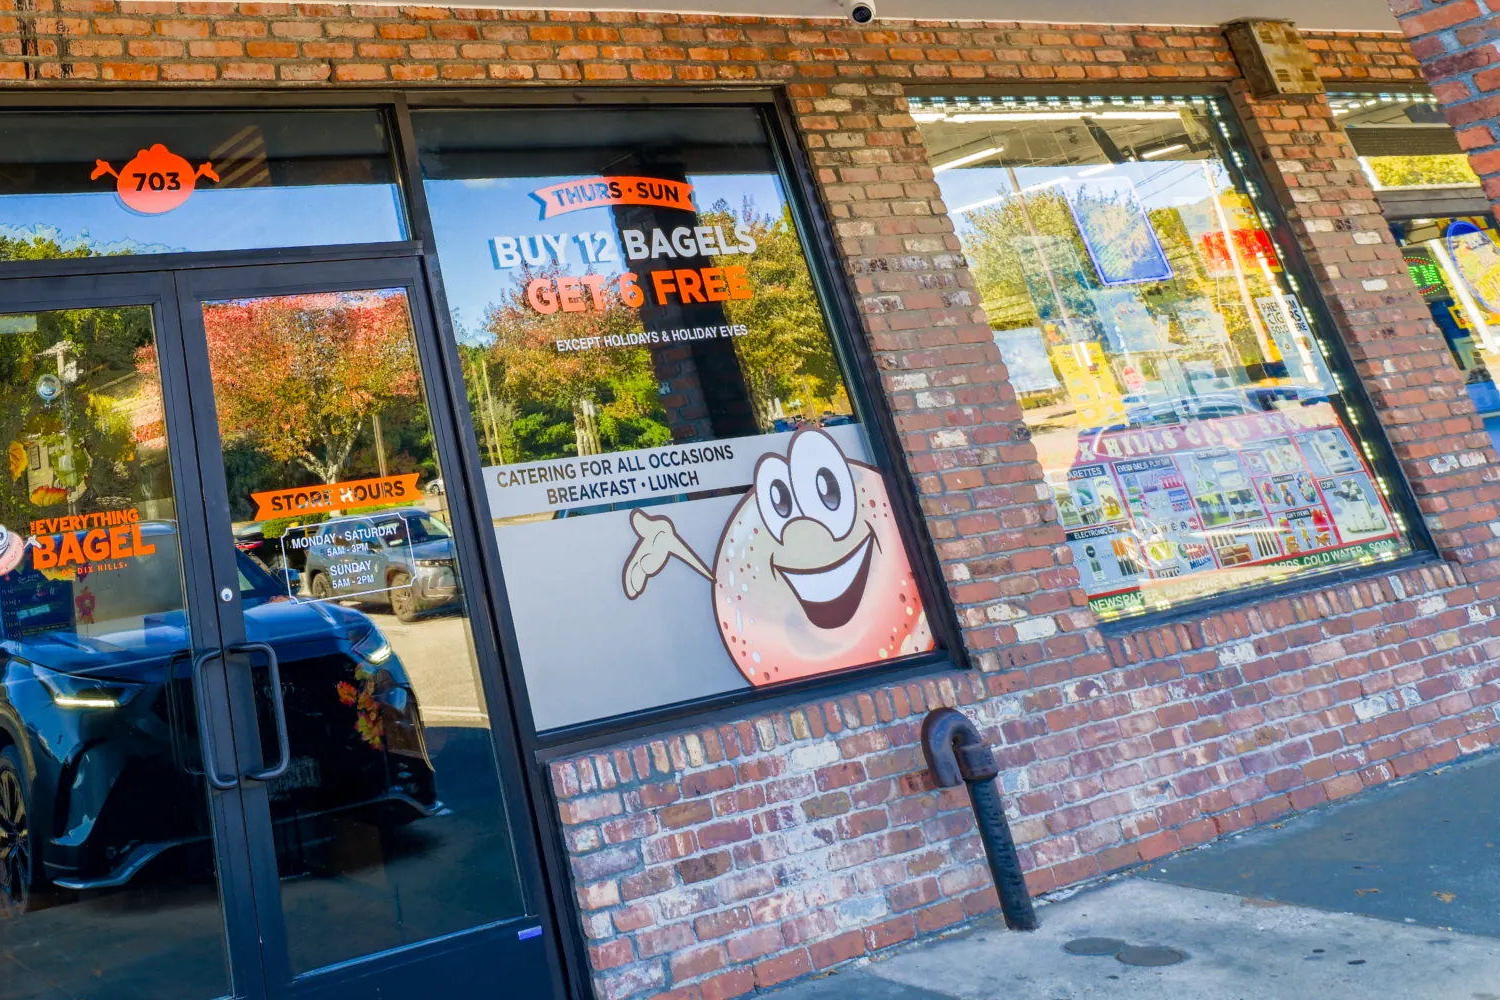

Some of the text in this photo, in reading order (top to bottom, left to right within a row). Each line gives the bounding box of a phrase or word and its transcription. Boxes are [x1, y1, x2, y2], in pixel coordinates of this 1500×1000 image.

[132, 172, 181, 191] 703
[552, 182, 679, 207] THURS SUN
[494, 225, 757, 268] BUY 12 BAGELS
[528, 266, 753, 315] GET 6 FREE
[1268, 310, 1301, 324] CIGRS
[556, 324, 748, 351] EXCEPT HOLIDAYS & HOLIDAY EVES
[1102, 430, 1179, 458] HILLS
[497, 445, 734, 489] CATERING FOR ALL OCCASIONS
[271, 481, 405, 511] STORE HOURS
[548, 470, 700, 504] BREAKFAST LUNCH
[36, 508, 139, 534] EVERYTHING
[1074, 528, 1107, 539] ELECTRONIC
[33, 524, 155, 569] BAGEL
[292, 525, 398, 549] MONDAY SATURDAY
[327, 546, 345, 557] 5AM
[352, 543, 368, 553] 3PM
[1304, 554, 1330, 566] COLD
[78, 565, 95, 575] DIX
[97, 563, 123, 571] HILLS
[330, 561, 371, 576] SUNDAY
[332, 578, 350, 589] 5AM
[357, 575, 374, 585] 2PM
